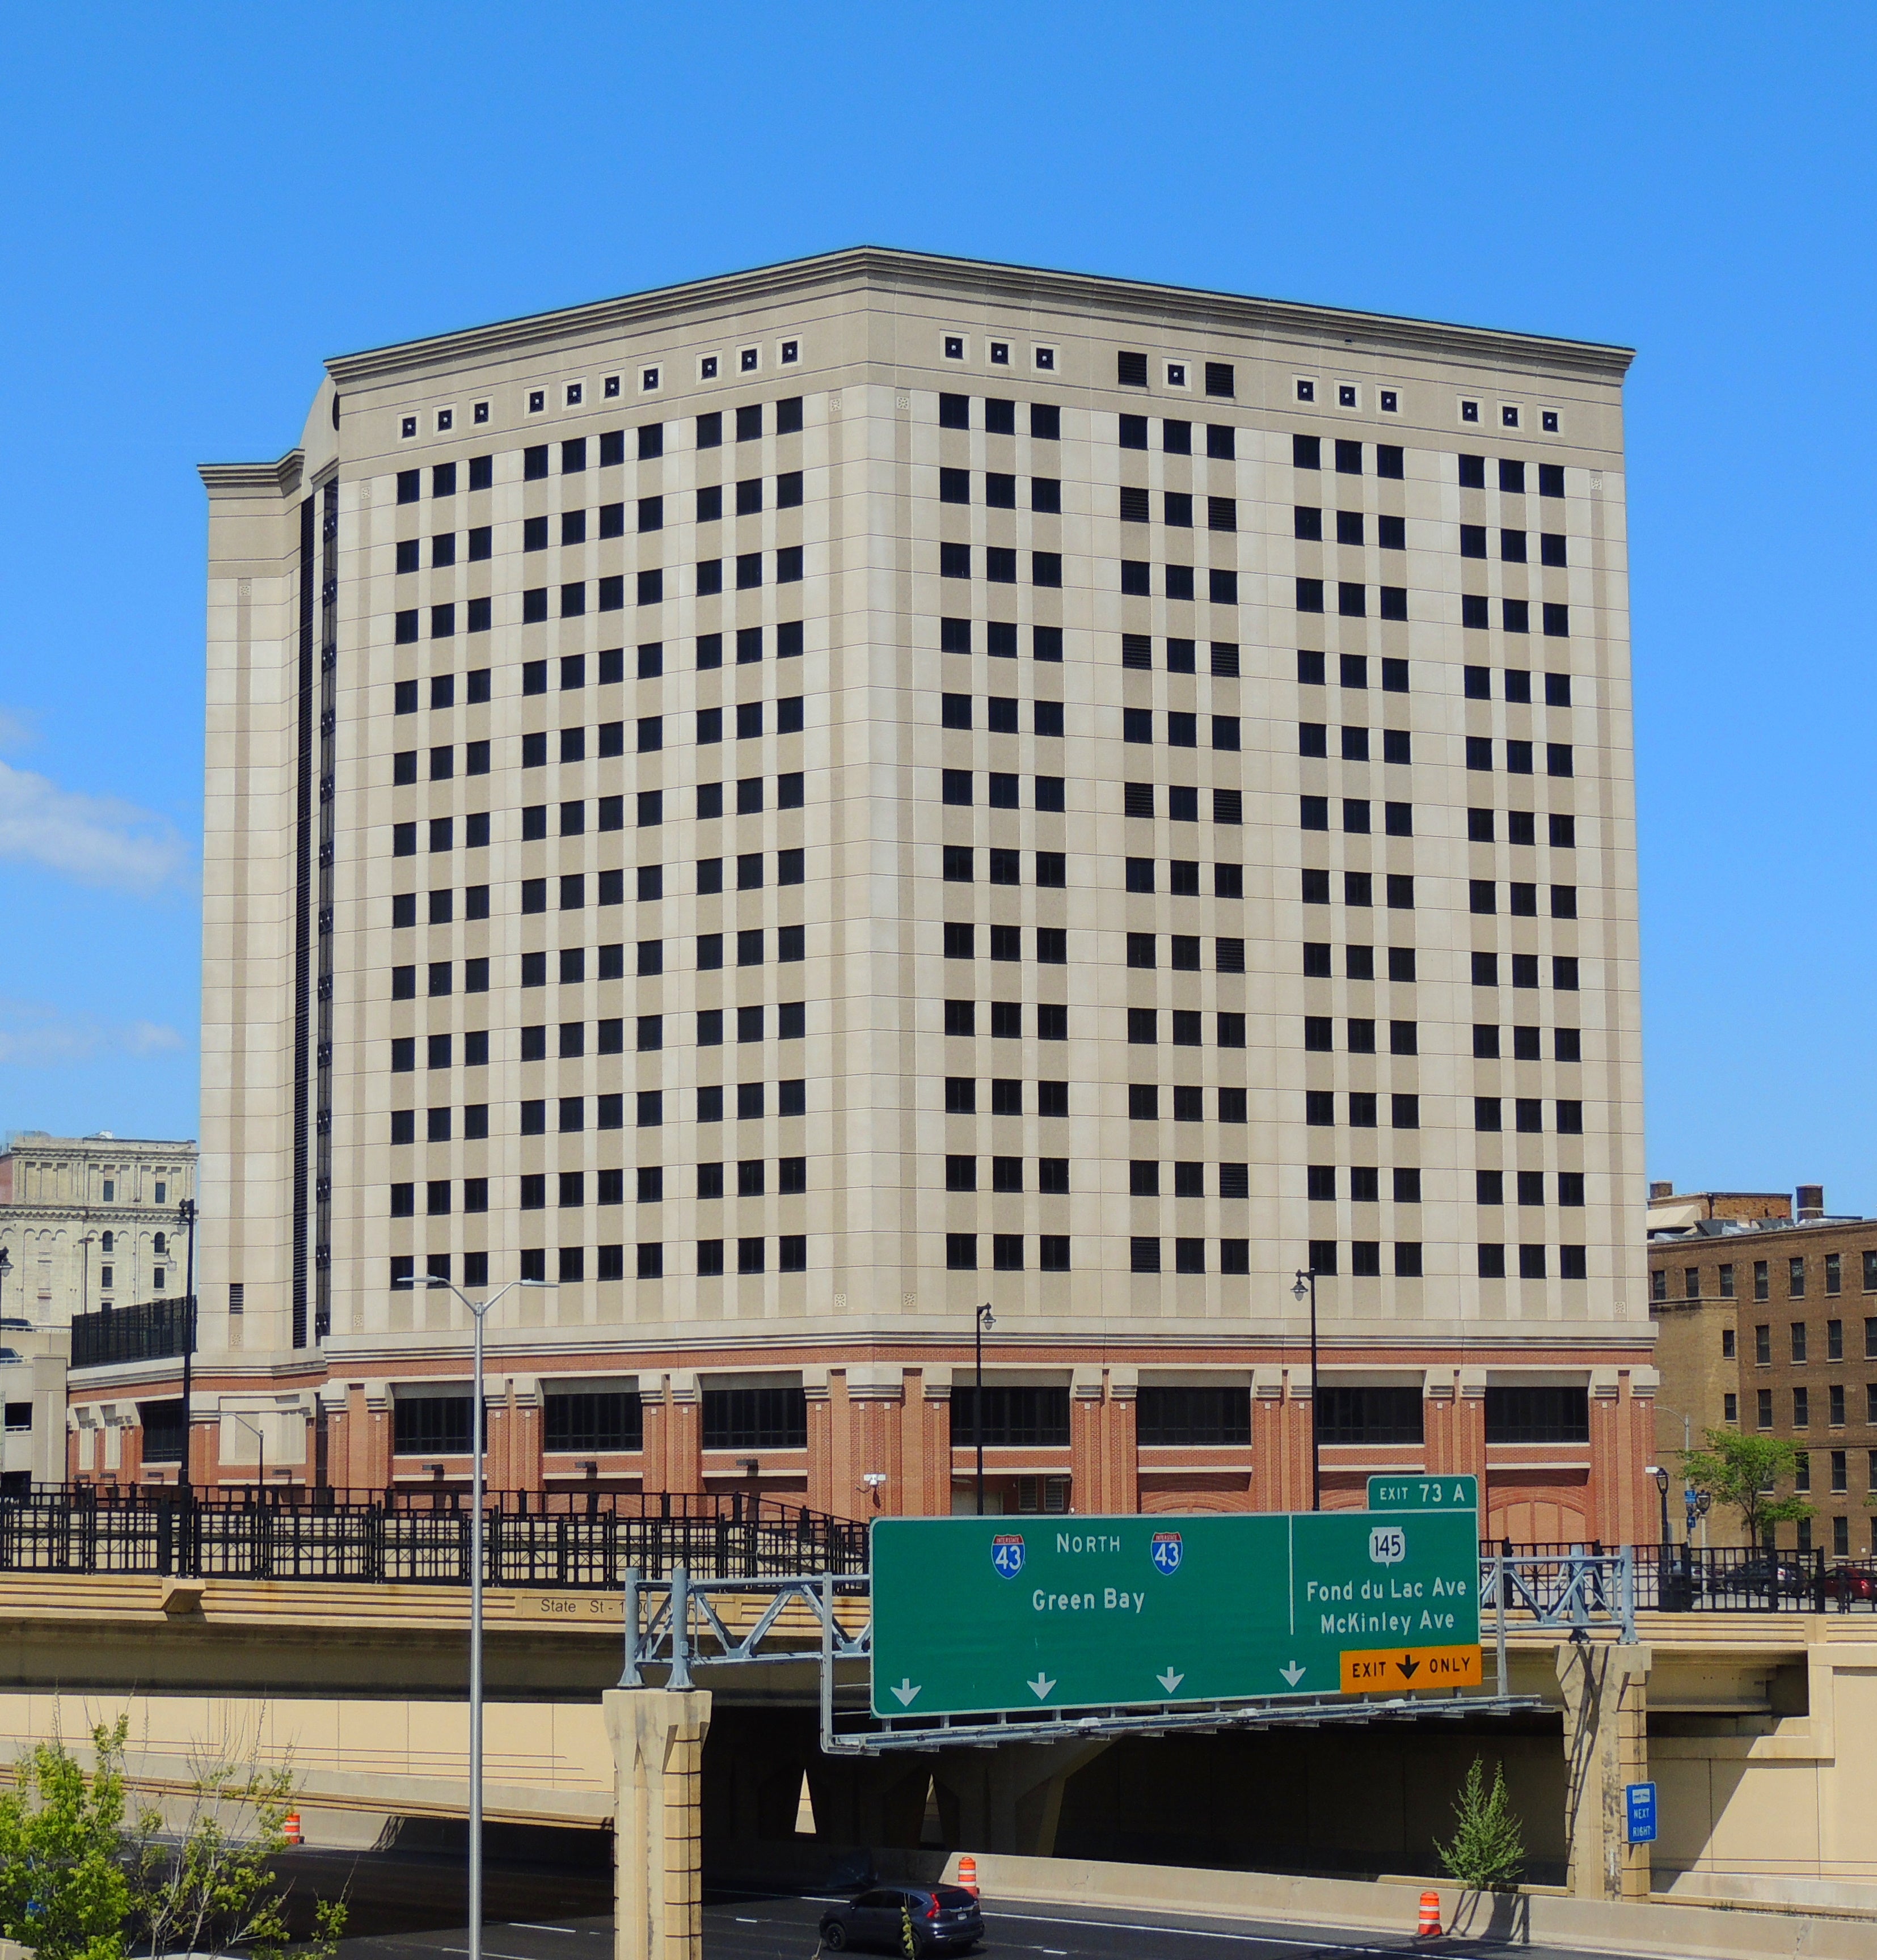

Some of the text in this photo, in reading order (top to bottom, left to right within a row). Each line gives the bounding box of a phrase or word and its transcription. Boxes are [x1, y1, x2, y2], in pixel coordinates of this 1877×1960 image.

[1380, 1484, 1465, 1502] EXIT 73 A
[1057, 1533, 1120, 1553] NORTH
[1374, 1535, 1401, 1557] 145
[995, 1545, 1021, 1570] 43
[1154, 1542, 1179, 1566] 43
[1307, 1577, 1466, 1601] Fond du Lac Ave
[541, 1599, 576, 1613] State
[589, 1600, 604, 1613] St
[1032, 1587, 1145, 1613] Green Bay
[1321, 1610, 1454, 1636] McKinley Ave
[1352, 1657, 1470, 1678] EXIT ONLY
[1634, 1807, 1650, 1819] NEXT
[1633, 1825, 1651, 1837] RIGHT
